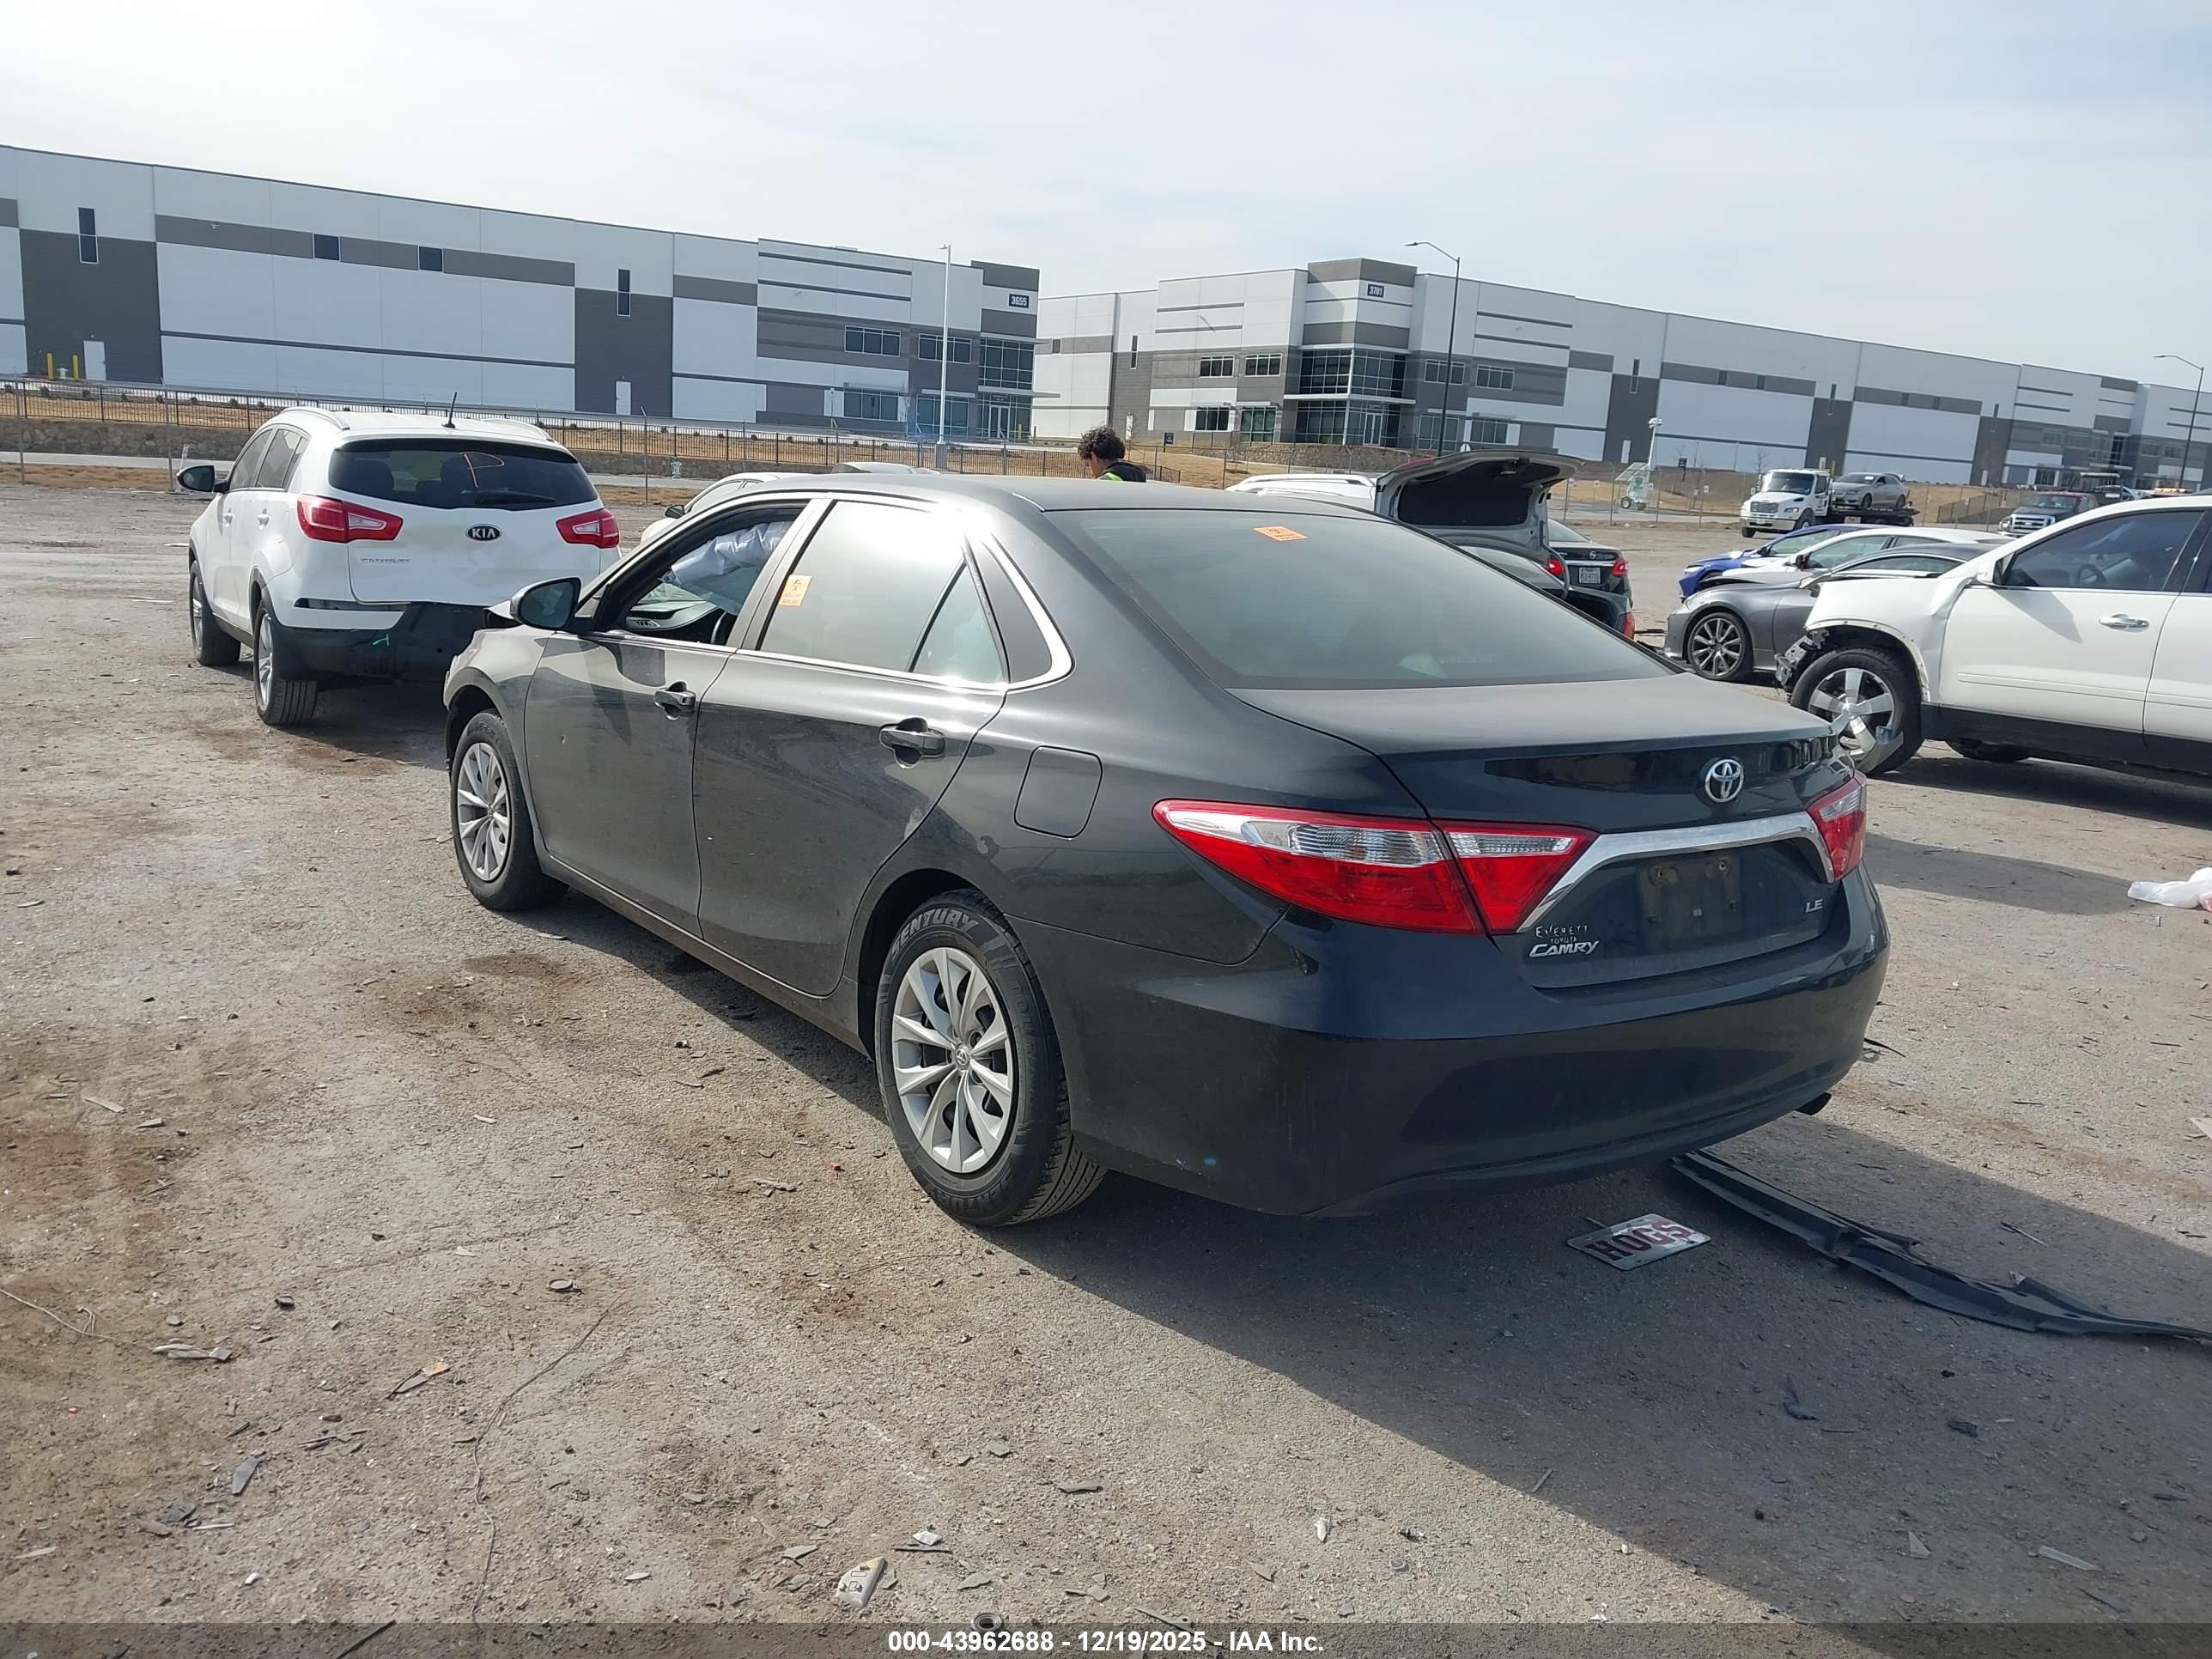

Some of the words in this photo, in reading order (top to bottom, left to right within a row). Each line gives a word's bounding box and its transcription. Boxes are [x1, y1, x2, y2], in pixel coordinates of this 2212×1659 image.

[471, 528, 496, 538] KIA
[1806, 899, 1824, 913] LE
[1550, 936, 1578, 945] TOYOTA
[1528, 940, 1601, 957] CAMRY
[1585, 1219, 1692, 1261] HOGS
